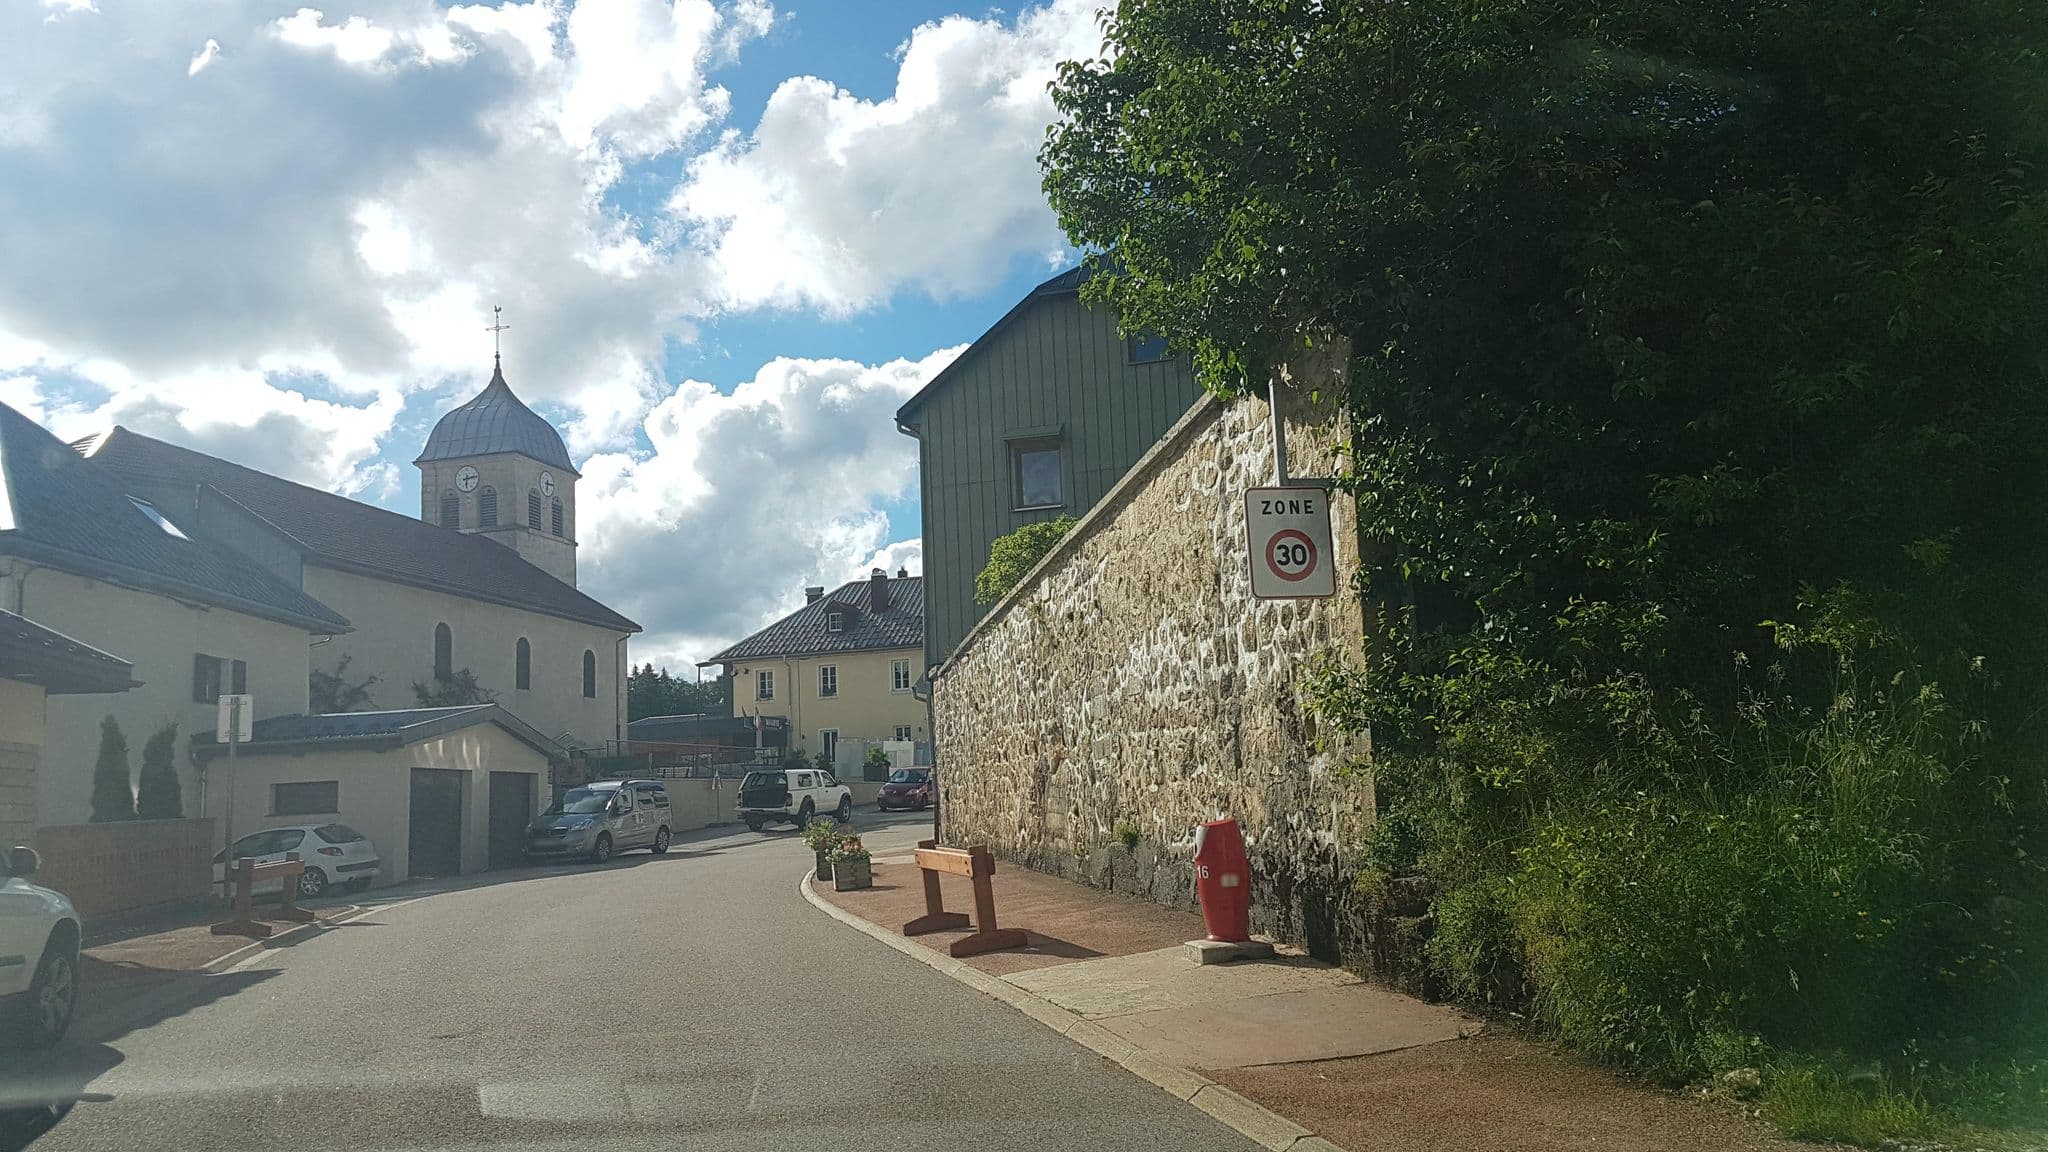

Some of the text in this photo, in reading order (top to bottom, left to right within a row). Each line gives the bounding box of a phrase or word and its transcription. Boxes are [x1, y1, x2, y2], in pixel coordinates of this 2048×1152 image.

[1261, 500, 1314, 515] ZONE
[1276, 544, 1307, 566] 30
[1197, 865, 1209, 879] 16
